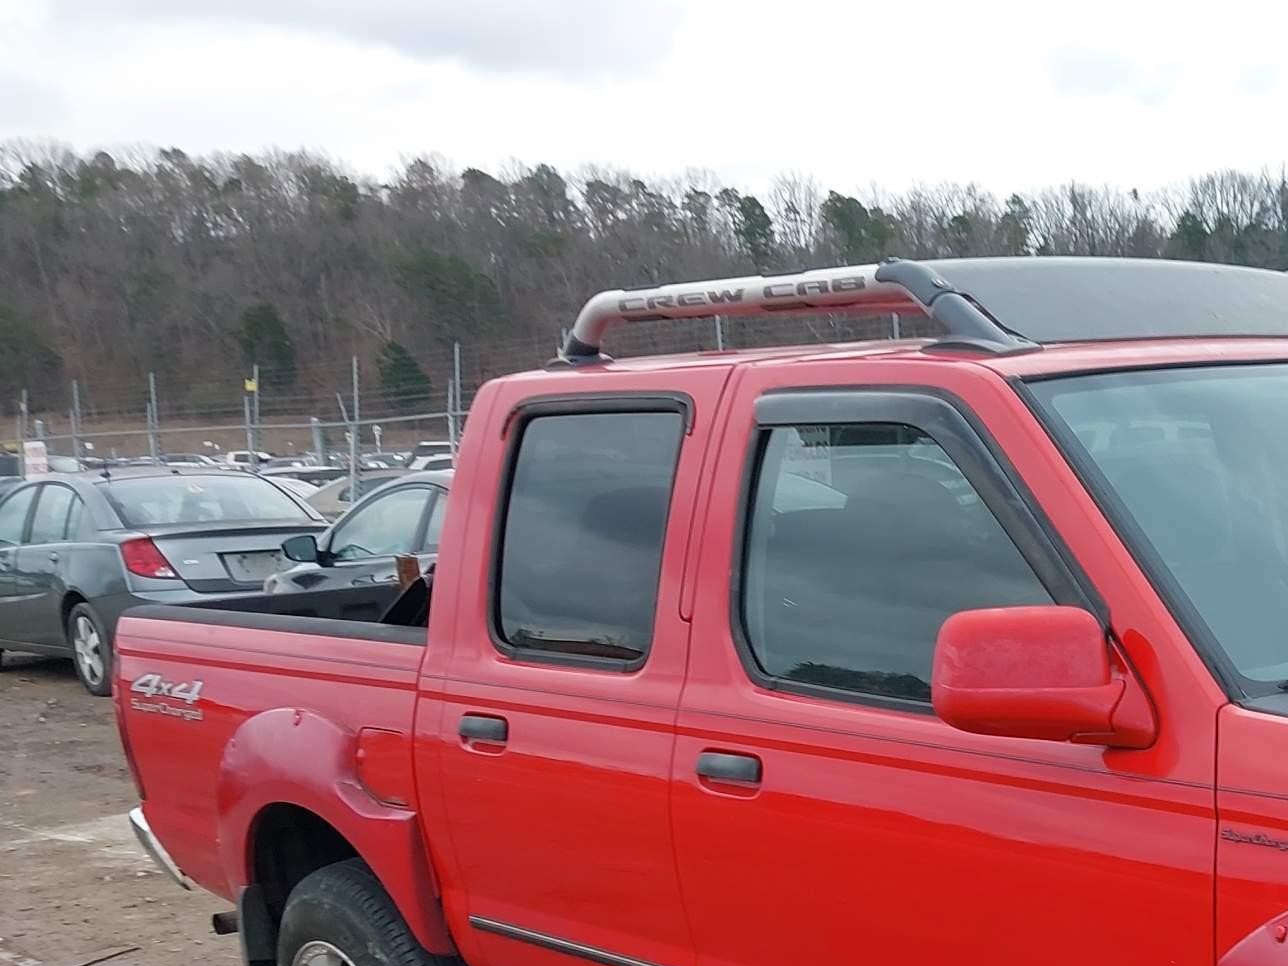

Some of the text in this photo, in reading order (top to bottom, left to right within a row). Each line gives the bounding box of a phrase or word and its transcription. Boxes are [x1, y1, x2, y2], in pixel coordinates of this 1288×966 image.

[617, 276, 867, 312] CREW CAB
[130, 674, 204, 705] 4x4
